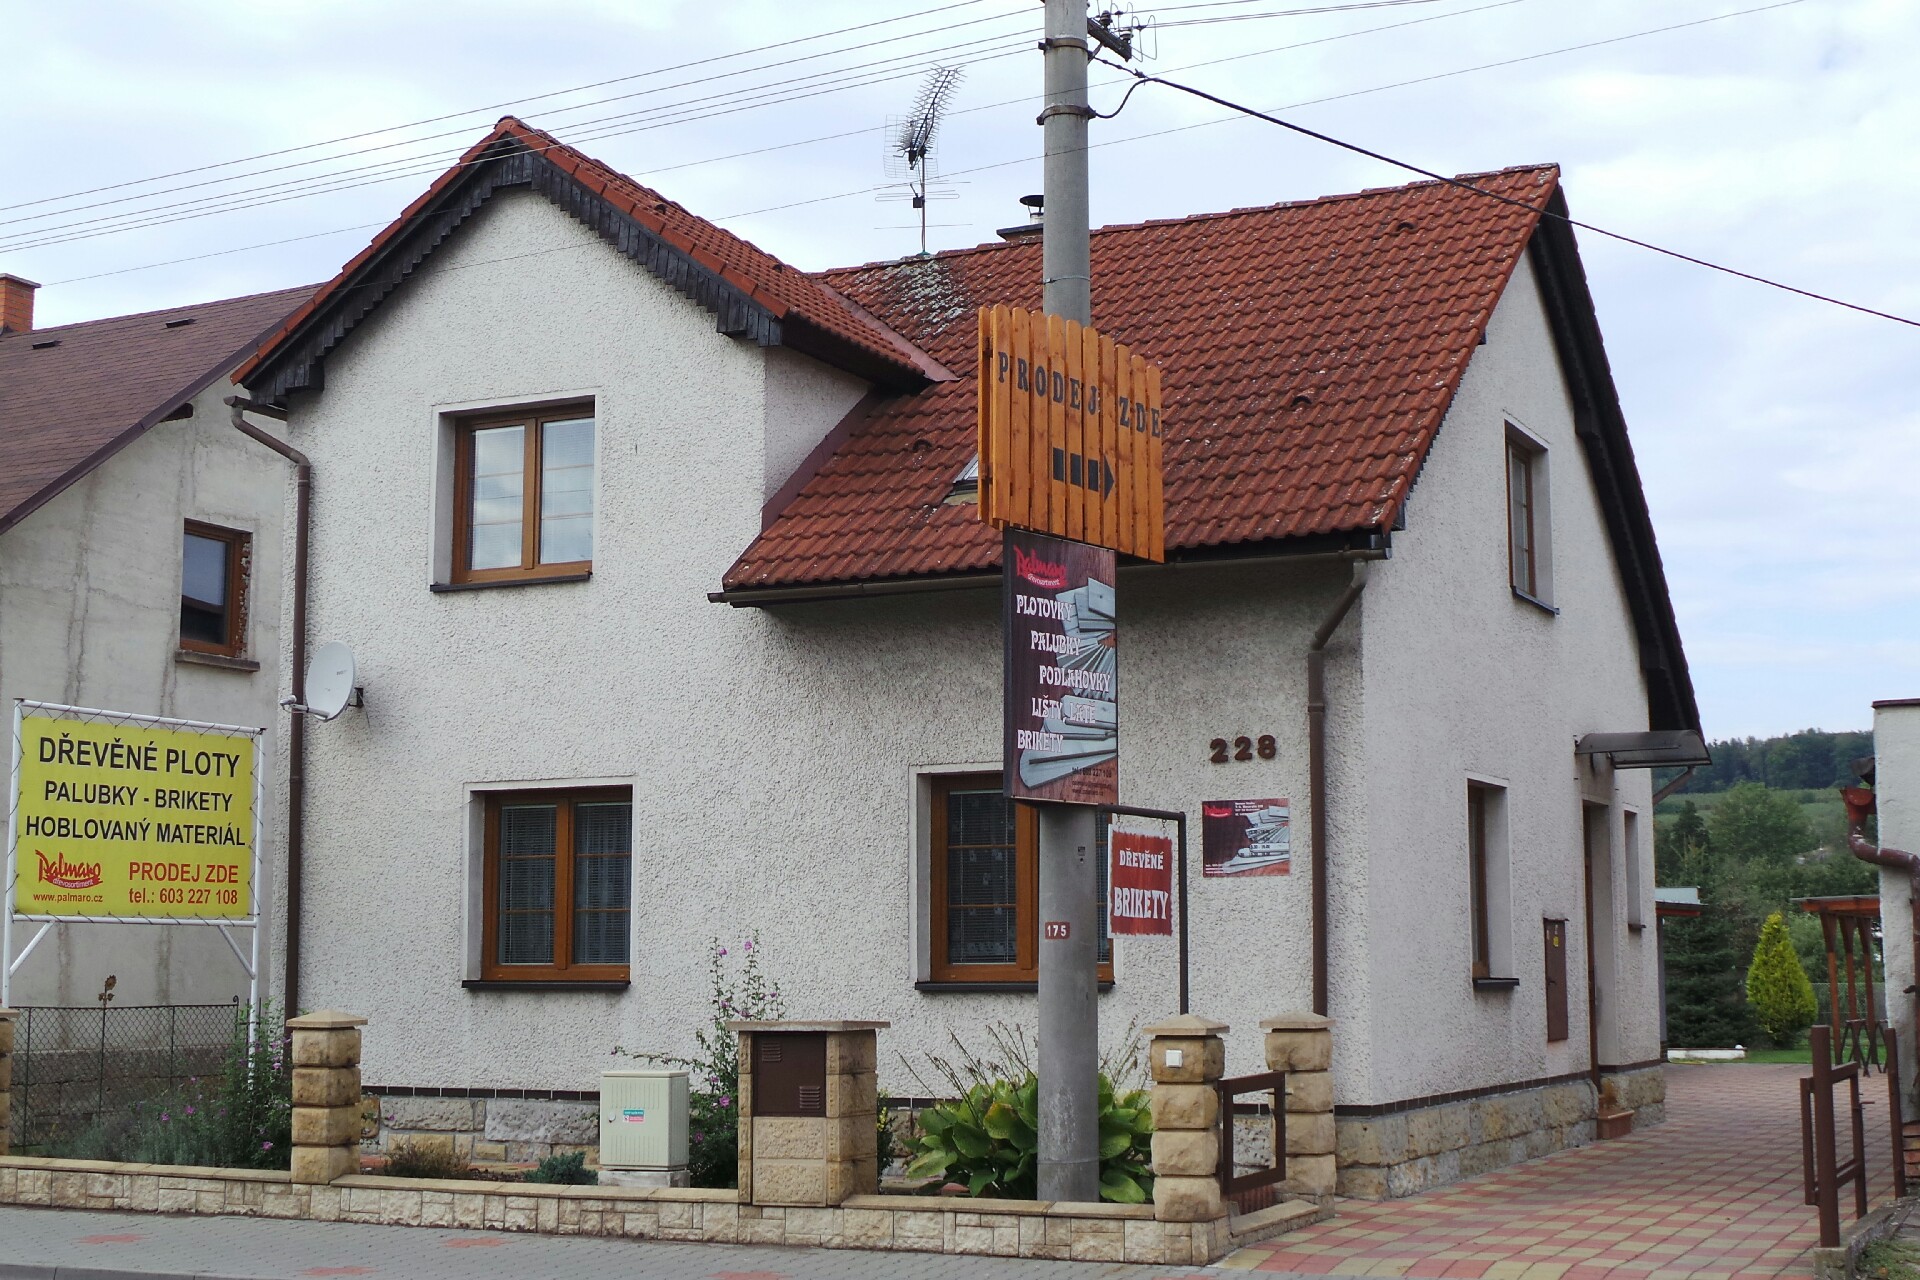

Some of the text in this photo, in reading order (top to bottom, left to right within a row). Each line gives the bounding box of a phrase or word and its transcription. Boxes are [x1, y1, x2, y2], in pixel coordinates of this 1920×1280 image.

[998, 351, 1161, 438] PRODEJ ZDE
[1016, 594, 1072, 621] PLOTOVKY
[1030, 630, 1081, 656] PALUBKY
[1039, 665, 1111, 692] PODLAHOVKY
[39, 732, 240, 777] DŘEVĚNÉ PLOTY
[1017, 729, 1064, 753] BRIKETY
[1210, 734, 1276, 763] 228
[44, 780, 139, 806] PALUBKY
[155, 788, 233, 812] BRIKETY
[26, 815, 246, 846] HOBLOVANÝ MATERIÁL
[35, 849, 101, 883] Palmaro
[129, 861, 239, 884] PRODEJ ZDE
[1119, 848, 1164, 870] DŘEVĚNÉ
[33, 892, 103, 904] www.palmaro.cz
[129, 888, 238, 905] tel.: 603 227 108
[1114, 887, 1168, 920] BRIKETY
[1047, 924, 1067, 937] 175
